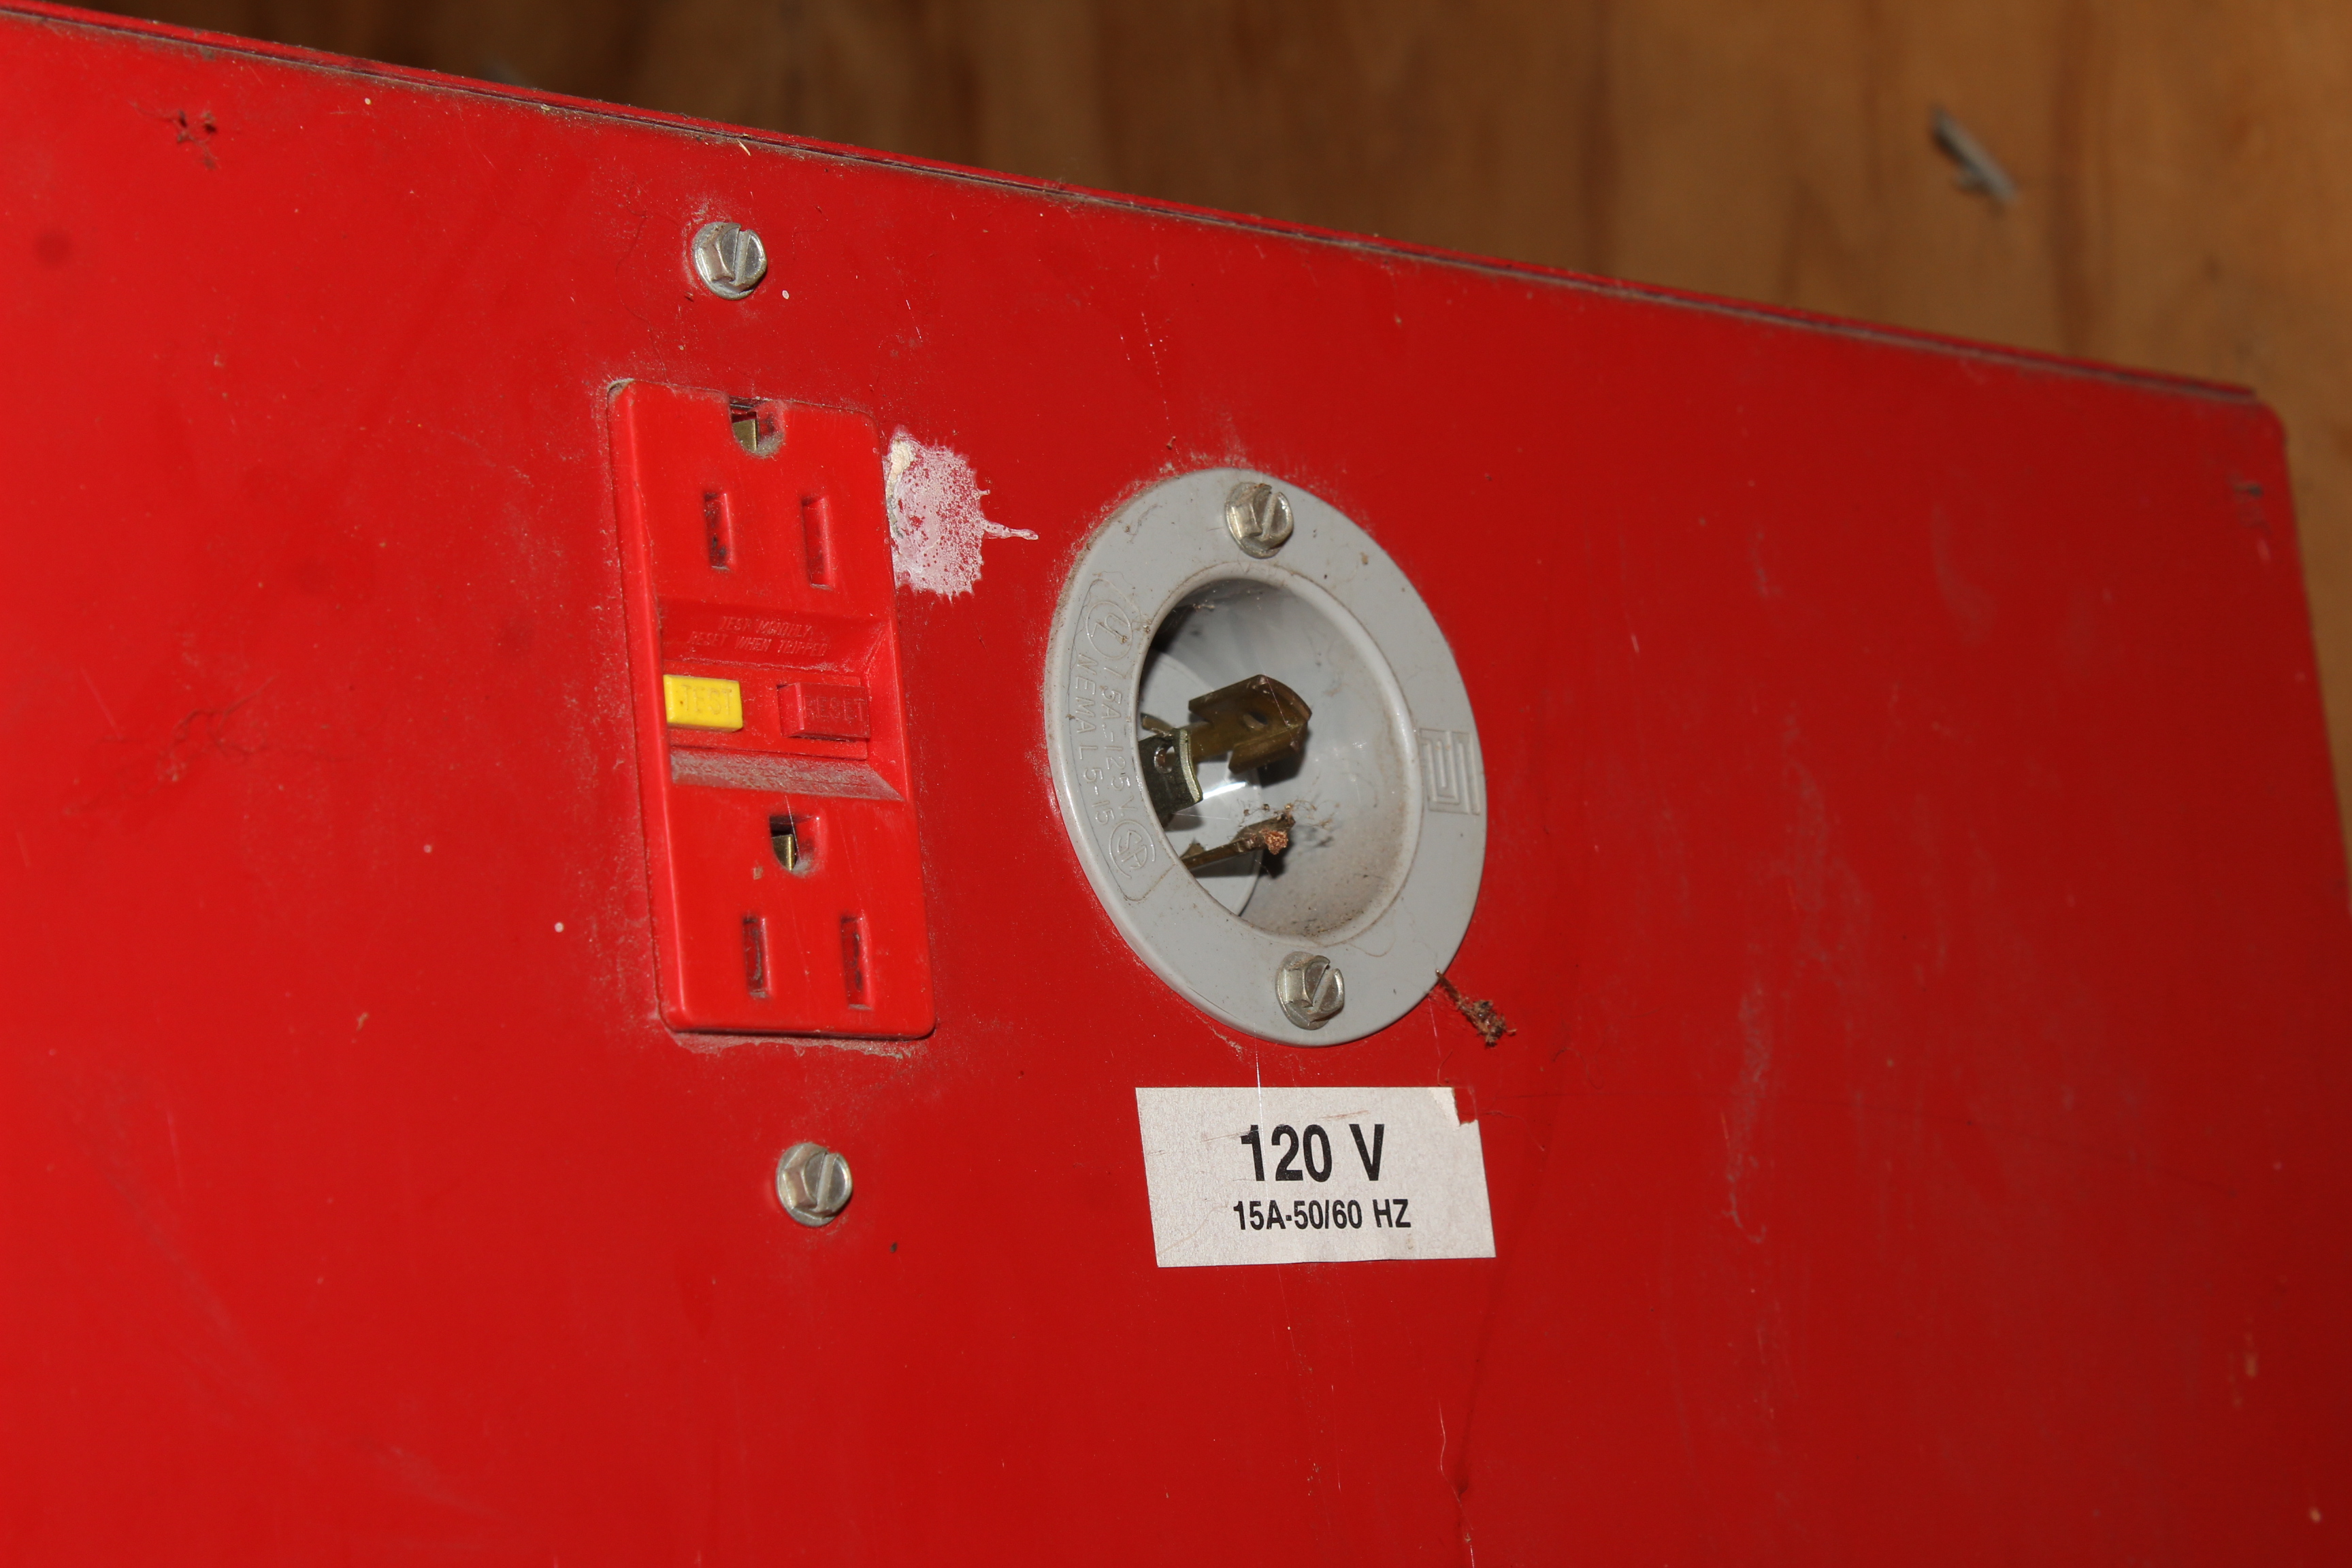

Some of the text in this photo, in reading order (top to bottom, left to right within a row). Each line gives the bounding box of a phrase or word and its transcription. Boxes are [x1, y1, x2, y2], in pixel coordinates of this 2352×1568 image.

[718, 616, 750, 633] TEST
[687, 632, 728, 647] RESET
[735, 635, 772, 652] WHEN
[681, 685, 733, 715] TEST
[802, 694, 866, 722] RESET
[1075, 653, 1098, 734] NEMA
[1241, 1124, 1385, 1182] 120 V
[1233, 1198, 1411, 1230] 15A-50/60 HZ
